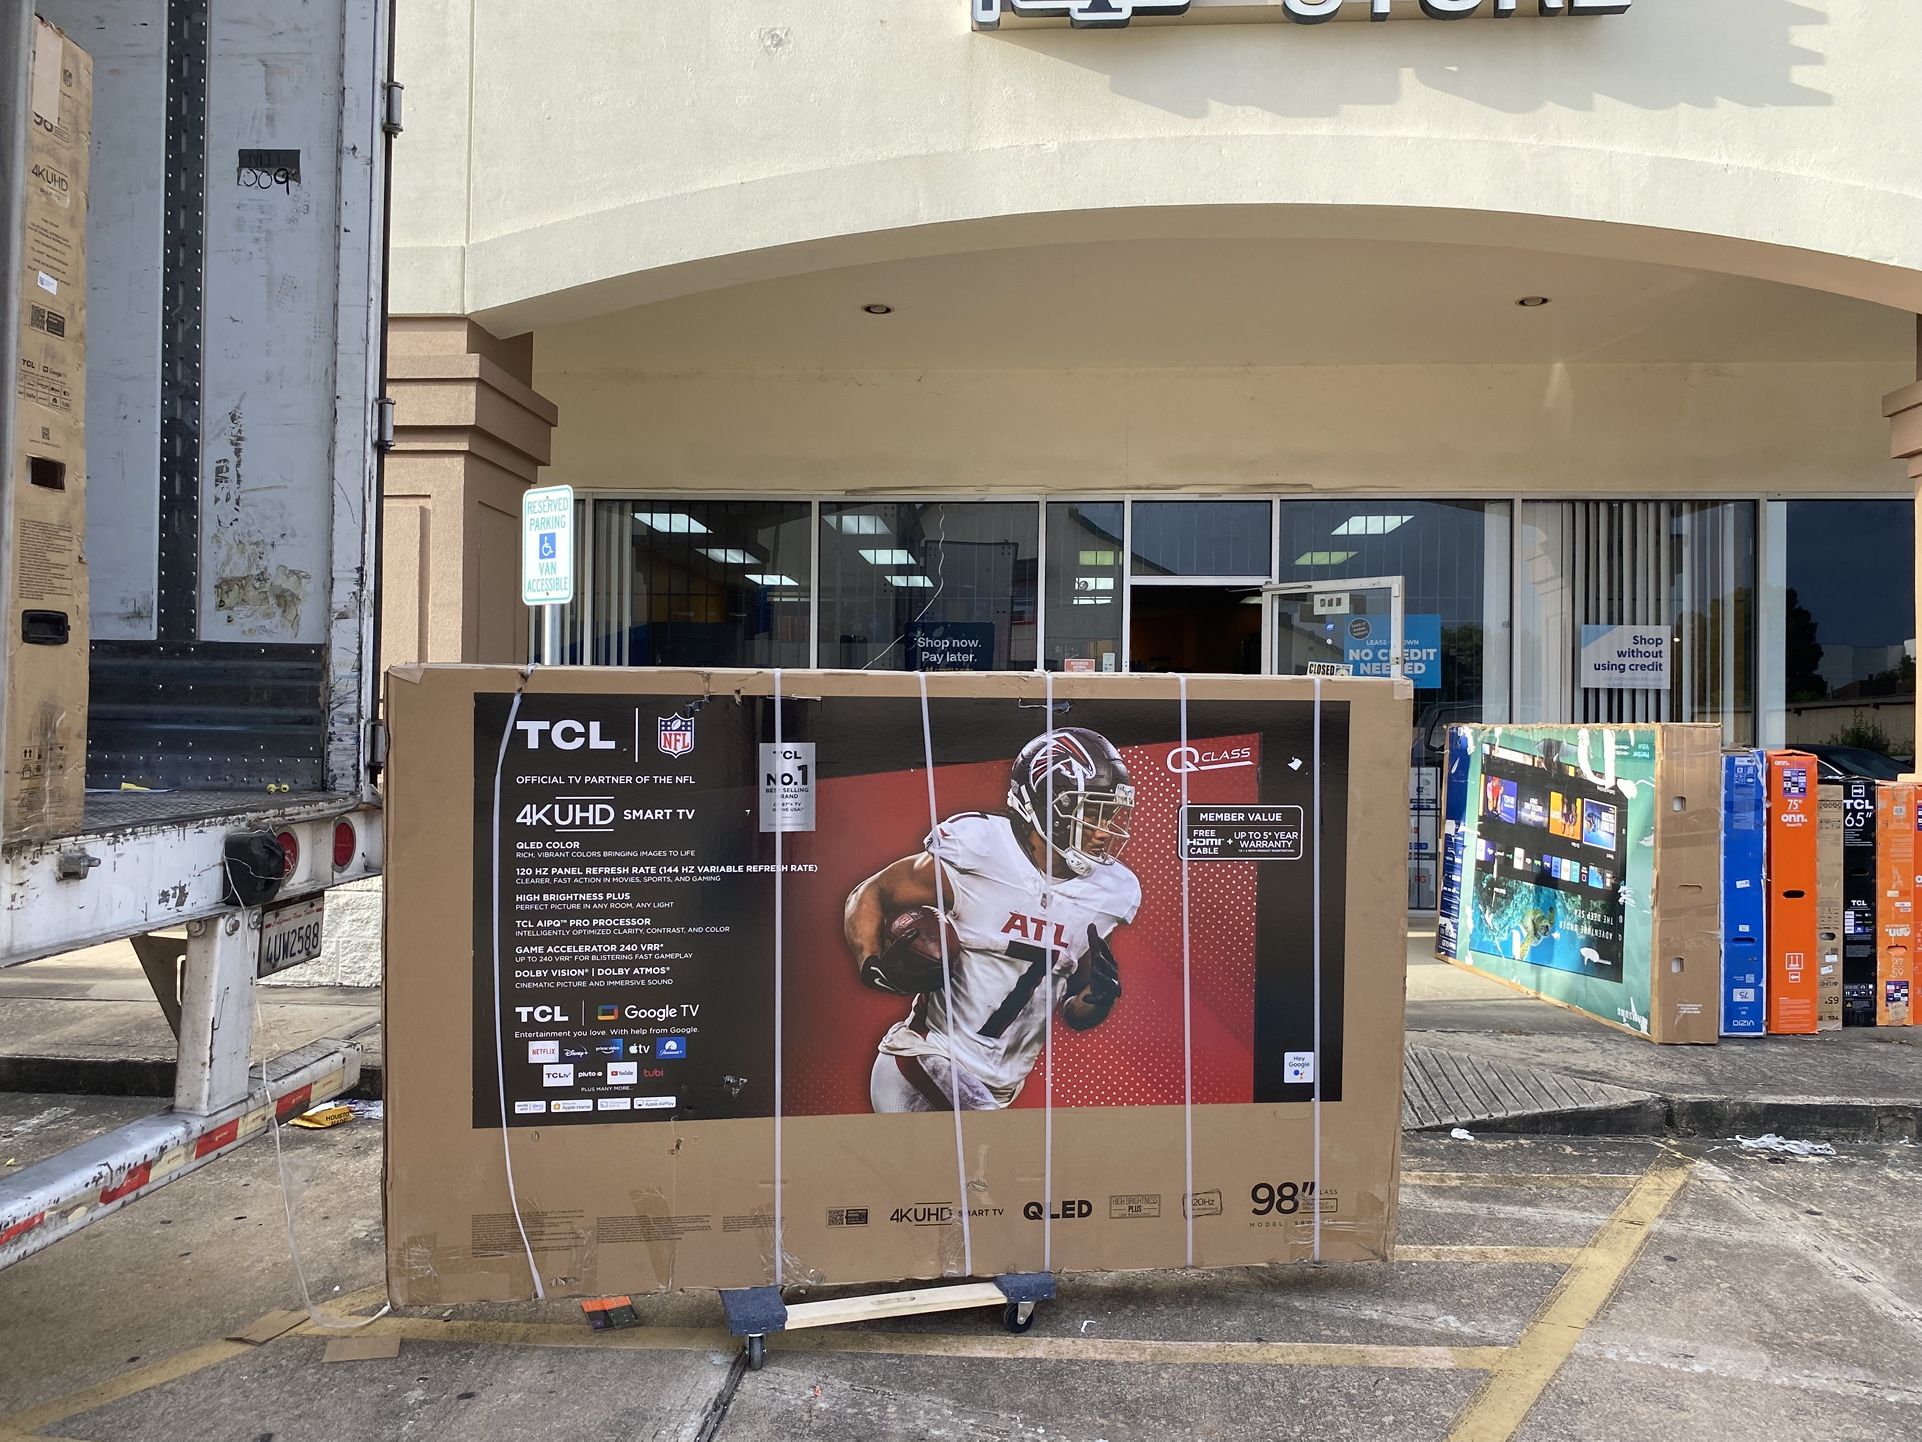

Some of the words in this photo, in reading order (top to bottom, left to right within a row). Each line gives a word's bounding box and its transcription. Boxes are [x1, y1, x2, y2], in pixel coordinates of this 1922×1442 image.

[32, 164, 68, 192] 4KUHD
[22, 358, 36, 368] TCL
[528, 498, 568, 514] RESERVED
[530, 515, 566, 532] PARKING
[538, 562, 556, 576] VAN
[527, 576, 568, 592] ACCESSIBLE
[918, 636, 950, 650] Shop
[952, 639, 982, 648] now.
[1632, 635, 1664, 647] Shop
[922, 652, 944, 664] Pay
[946, 652, 977, 662] later.
[1348, 649, 1372, 660] NO
[1378, 648, 1437, 660] CEDIT
[1616, 648, 1663, 658] without
[1308, 664, 1335, 676] CLOSED
[1360, 662, 1426, 674] NEEED
[1594, 661, 1626, 673] using
[1628, 661, 1664, 672] credit
[516, 719, 616, 750] TCL
[662, 732, 690, 751] NFL
[1201, 748, 1251, 762] CLASS
[516, 776, 565, 784] OFFICIAL
[568, 776, 582, 784] TV
[584, 776, 632, 784] PARTNER
[635, 776, 650, 784] OF
[652, 776, 672, 784] THE
[675, 776, 696, 784] NFL
[1788, 800, 1803, 810] 75"
[1843, 800, 1874, 810] TCL
[516, 803, 615, 826] 4KUHD
[624, 809, 673, 820] SMART
[676, 809, 696, 820] TV
[1200, 812, 1244, 822] MEMBER
[1248, 812, 1282, 822] VALUE
[1780, 813, 1808, 822] onn.
[1844, 812, 1872, 827] 65"
[516, 842, 543, 850] QLED
[546, 841, 580, 849] COLOR
[660, 866, 679, 874] (144
[698, 866, 744, 874] VARIABLE
[790, 864, 818, 872] RATE)
[543, 893, 604, 901] BRIGHTNESS
[1574, 910, 1584, 918] SEA
[1586, 912, 1601, 922] DEEP
[1603, 915, 1614, 925] THE
[592, 918, 651, 926] PROCESSOR
[1559, 922, 1578, 932] UNDER
[1001, 912, 1068, 948] ATL
[1580, 926, 1612, 940] ADVENTURE
[1885, 928, 1911, 936] onn.
[516, 946, 544, 954] GAME
[547, 944, 616, 953] ACCELERATOR
[516, 969, 548, 978] DOLBY
[598, 968, 630, 976] DOLBY
[977, 940, 1060, 1038] 7
[516, 1006, 568, 1022] TCL
[624, 1004, 678, 1022] Google
[680, 1004, 700, 1016] TV
[515, 1030, 570, 1038] Entertainment
[631, 1028, 648, 1036] help
[670, 1026, 700, 1034] Google.
[644, 1068, 664, 1077] tubi
